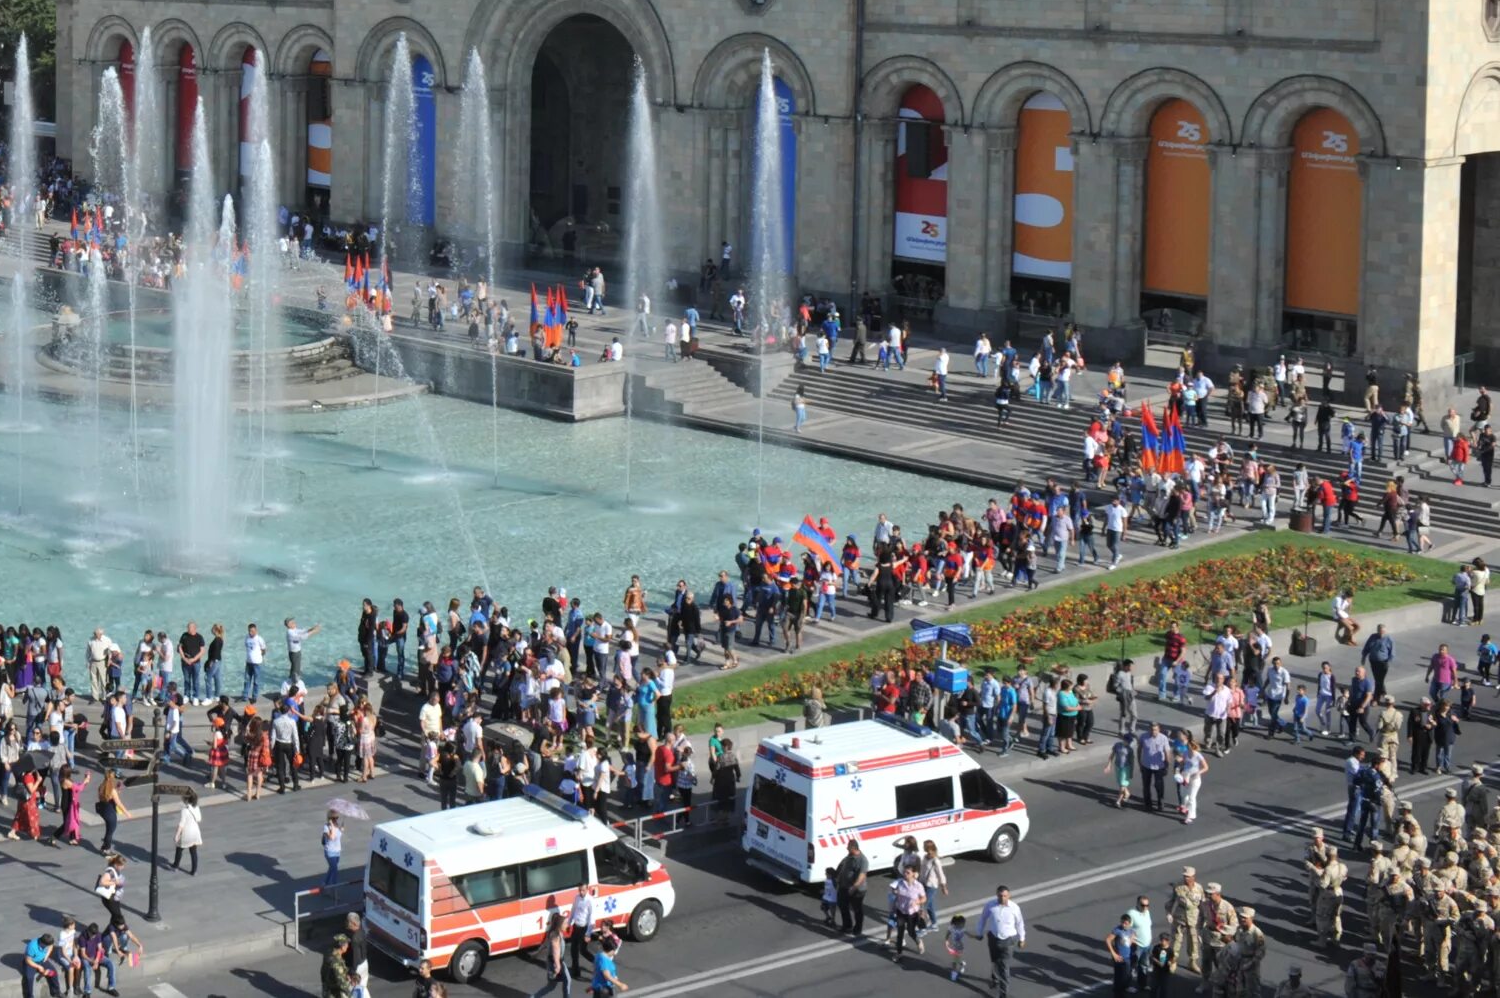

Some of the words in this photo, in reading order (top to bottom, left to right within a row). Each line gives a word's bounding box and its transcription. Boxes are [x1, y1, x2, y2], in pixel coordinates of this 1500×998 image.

[421, 71, 434, 87] 25
[1177, 120, 1201, 141] 25
[1322, 130, 1348, 153] 25
[921, 220, 939, 238] 25
[901, 815, 949, 833] REANIMATION
[407, 928, 418, 943] 51
